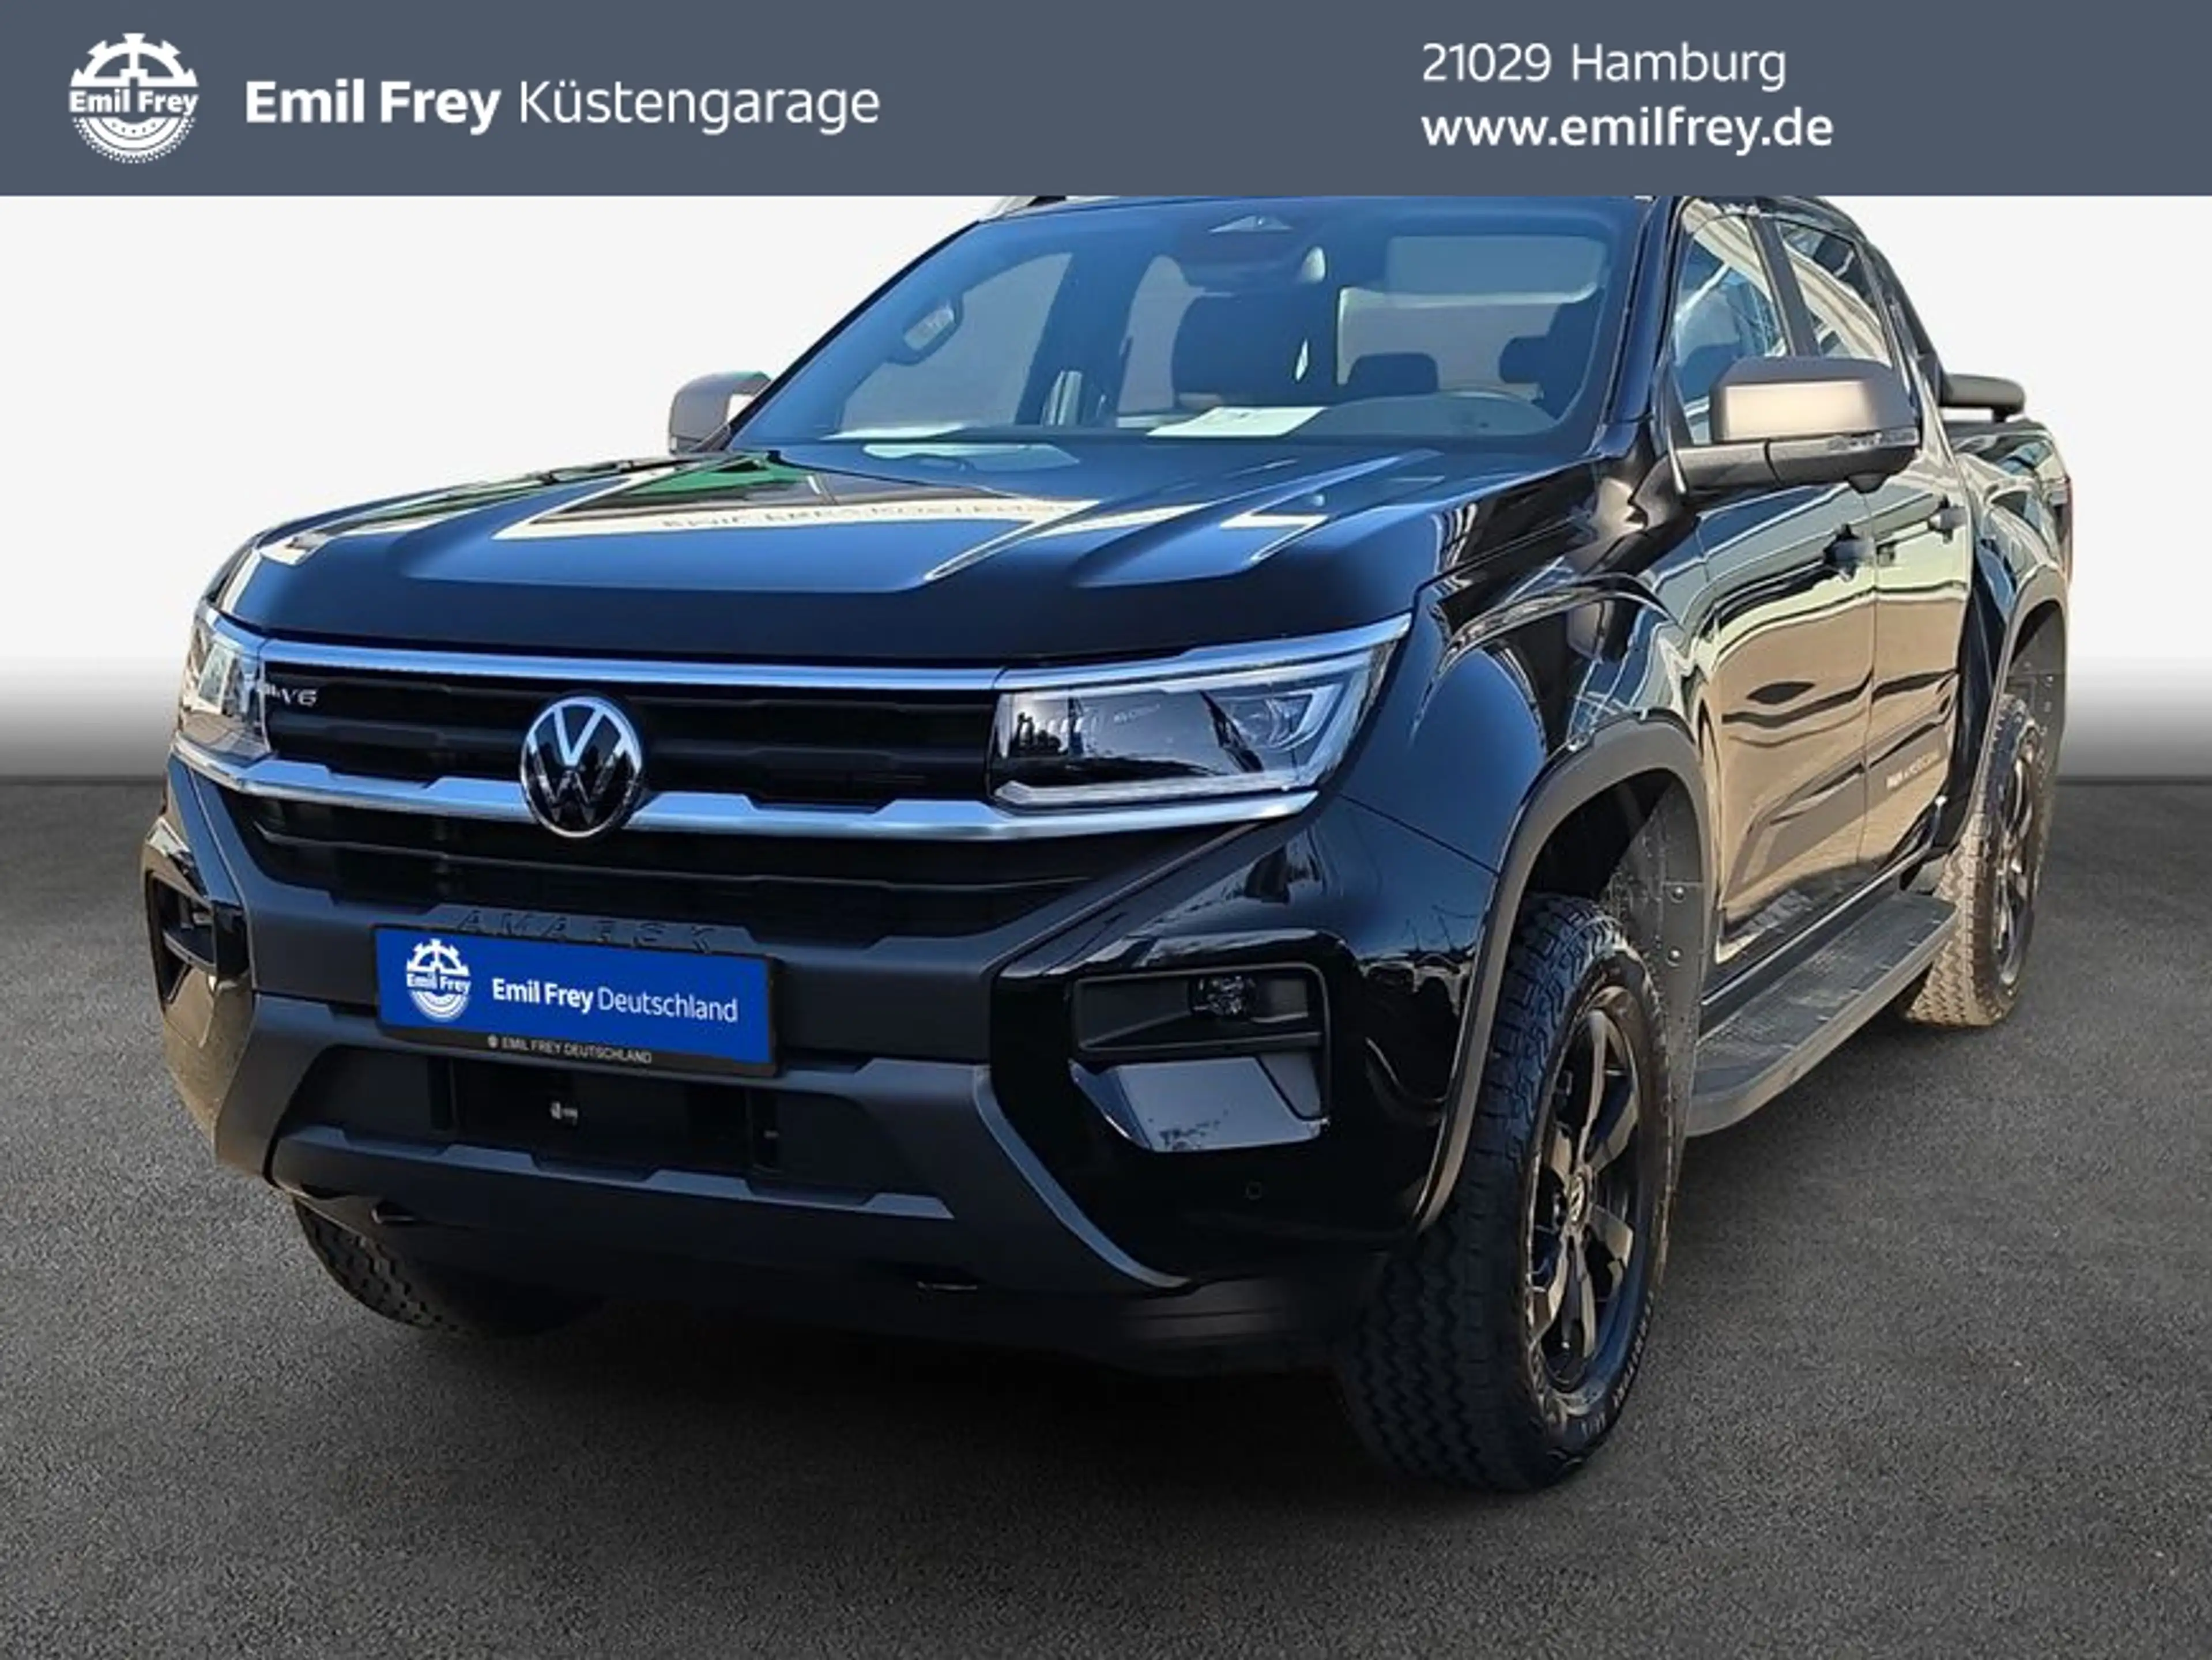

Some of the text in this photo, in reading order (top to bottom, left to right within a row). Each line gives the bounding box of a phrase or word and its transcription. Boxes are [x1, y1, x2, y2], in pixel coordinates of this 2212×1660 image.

[406, 972, 472, 995] Emil Frey
[491, 976, 738, 1023] Emil Frey Deutschland
[501, 1036, 653, 1064] EMIL FREY DEUTSCHLAND
